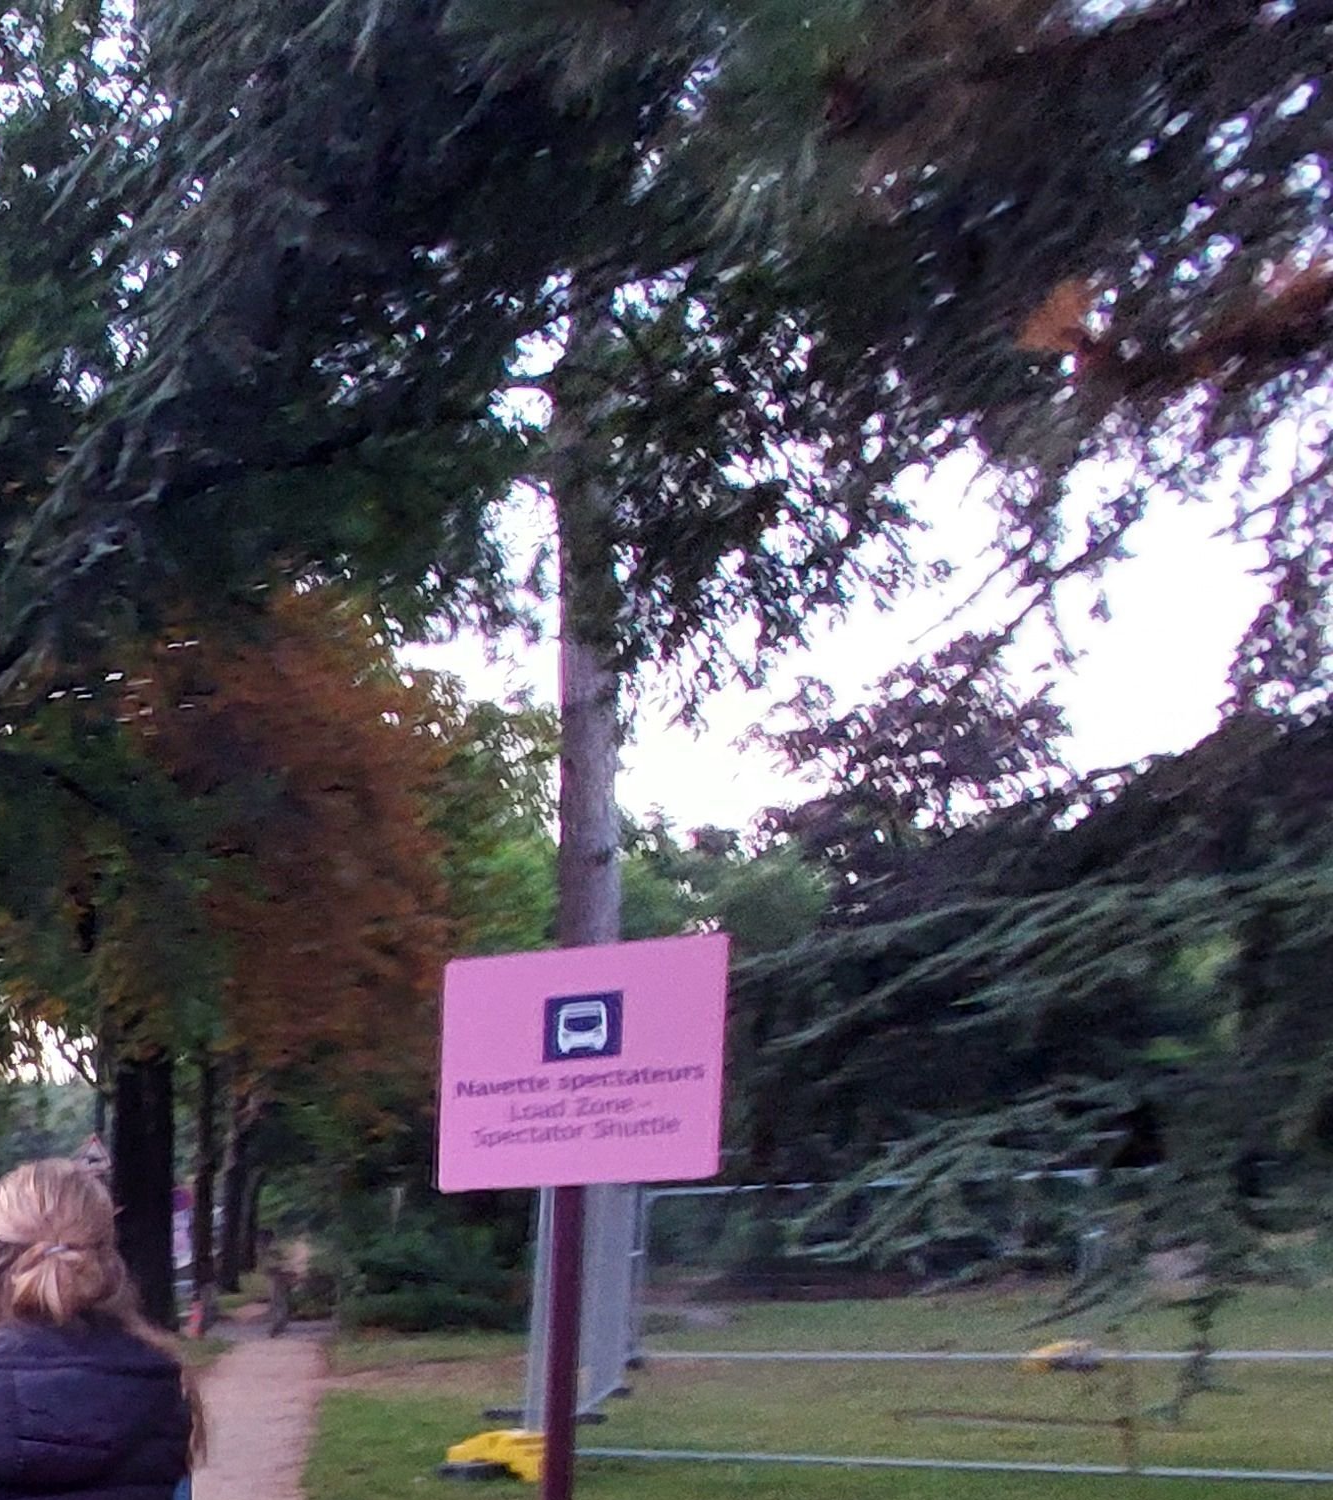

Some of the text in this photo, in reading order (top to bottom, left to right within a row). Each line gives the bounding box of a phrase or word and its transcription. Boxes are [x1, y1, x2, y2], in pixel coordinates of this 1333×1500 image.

[455, 1063, 706, 1098] Navette spectateurs
[508, 1100, 567, 1122] Load
[575, 1097, 635, 1118] Zone
[473, 1116, 681, 1148] Spectator Shuttle
